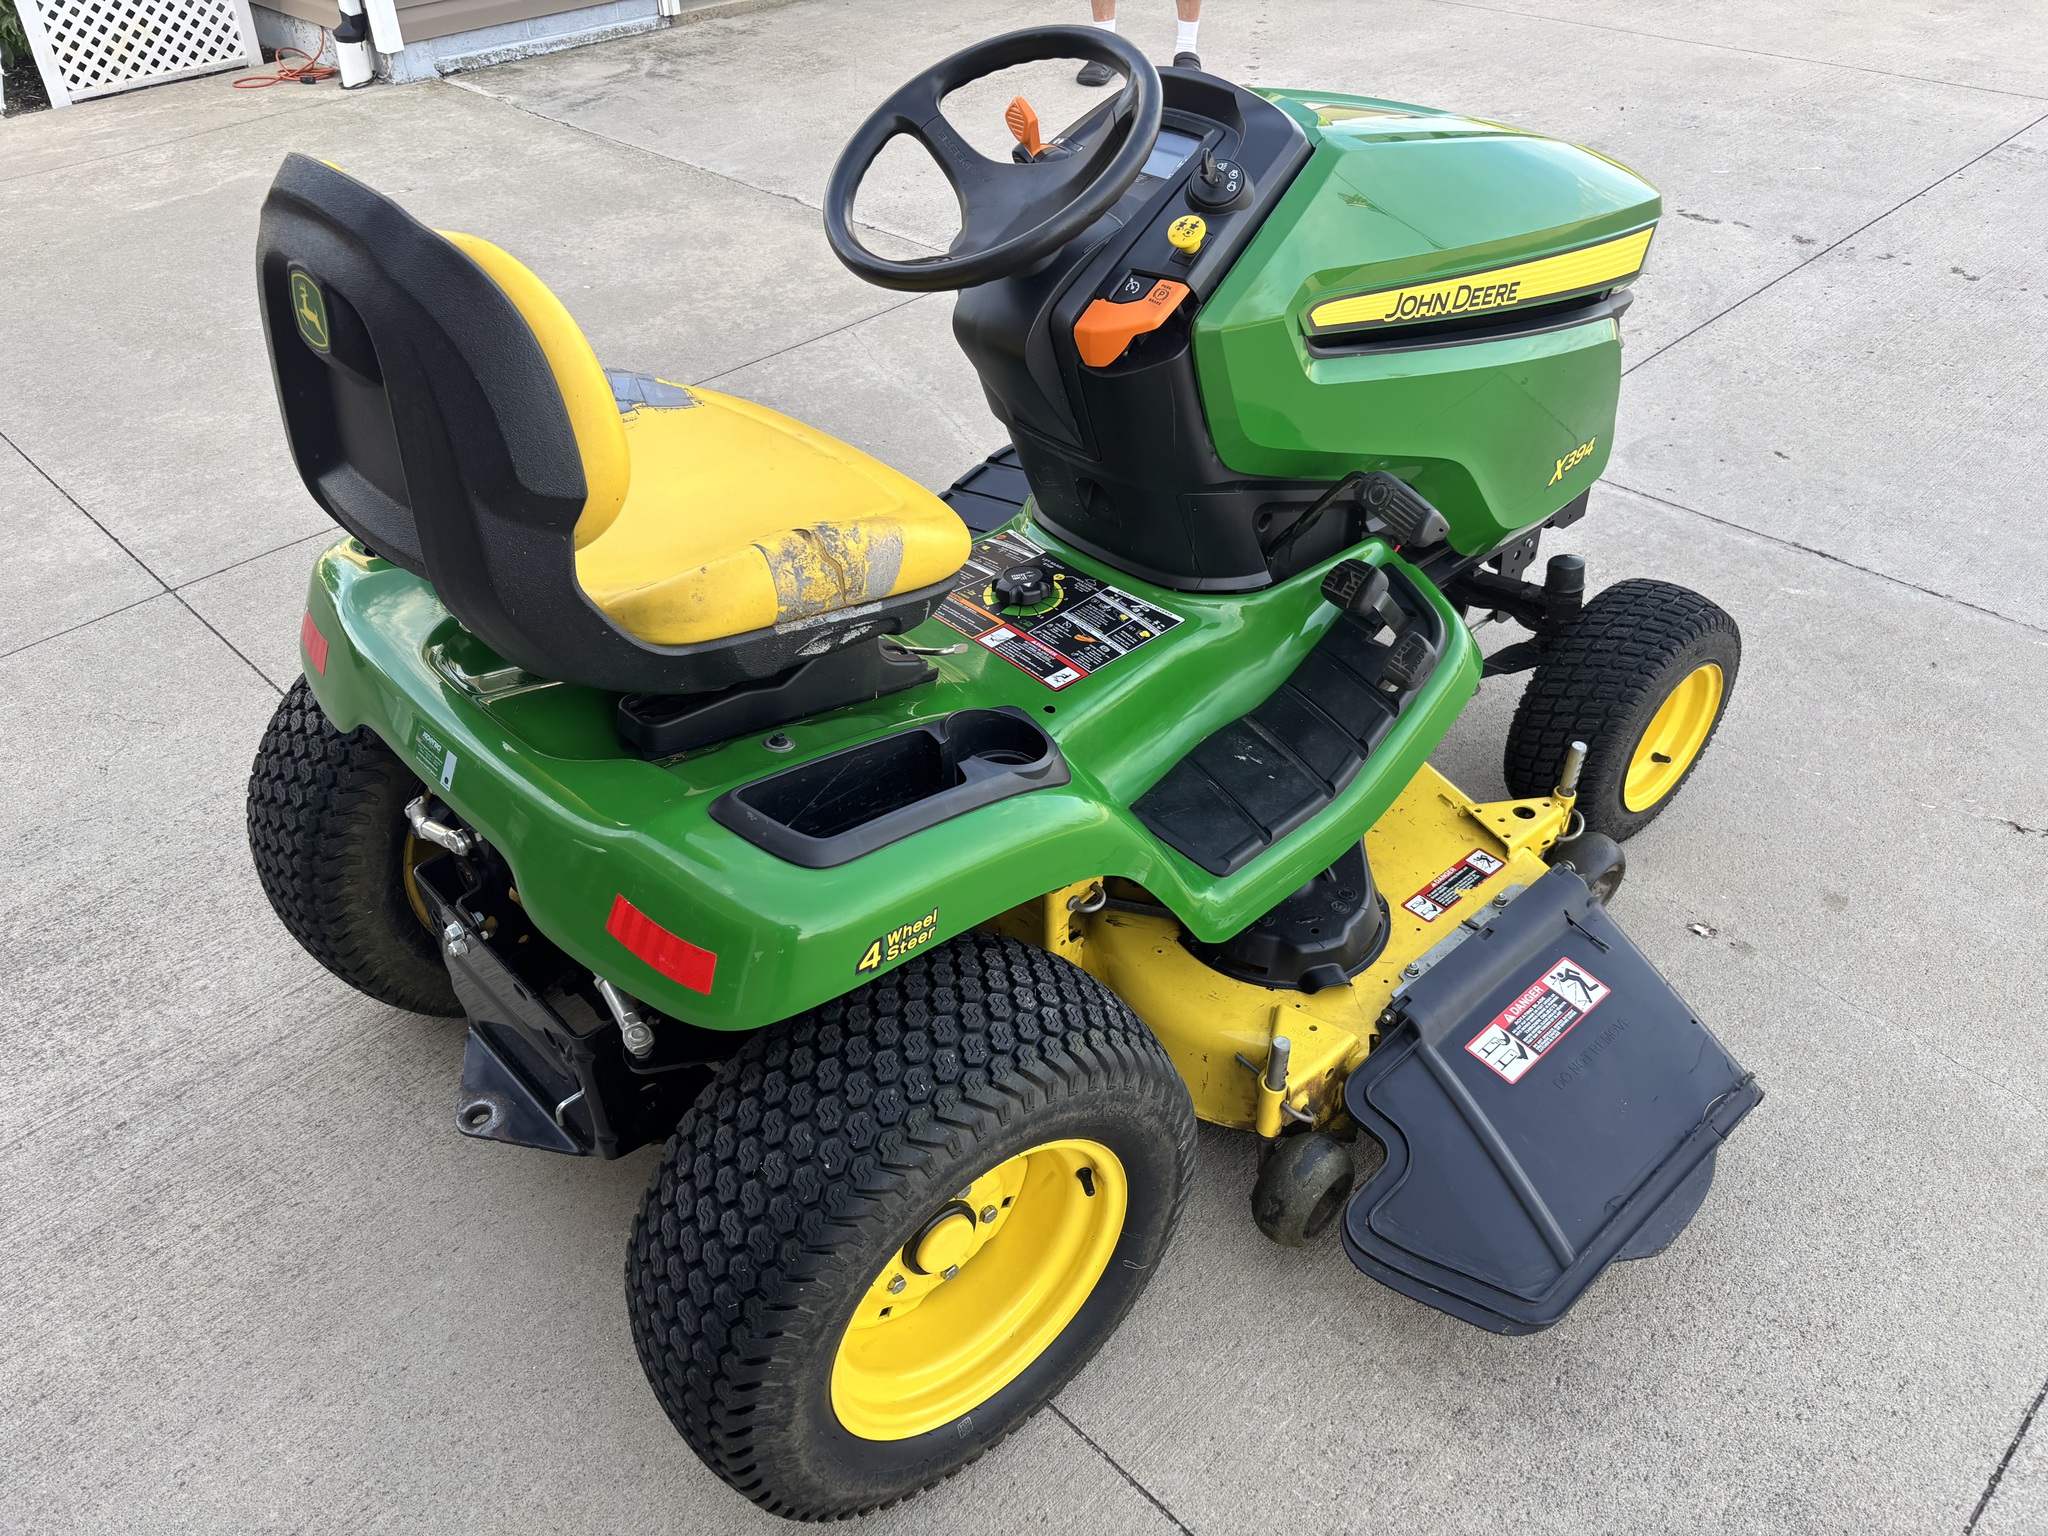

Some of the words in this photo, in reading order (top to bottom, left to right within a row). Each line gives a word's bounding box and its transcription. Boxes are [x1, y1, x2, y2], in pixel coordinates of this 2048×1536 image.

[1385, 292, 1450, 320] JOHN
[1452, 282, 1521, 310] DEERE
[1547, 436, 1596, 488] X394
[1034, 642, 1058, 656] DANGER
[1433, 867, 1457, 884] DANGER
[886, 926, 936, 962] Steer
[887, 908, 938, 948] Wheel
[856, 938, 883, 974] 4
[1509, 986, 1543, 1015] DANGER
[1552, 1072, 1572, 1090] DO
[1568, 1051, 1592, 1075] NOT
